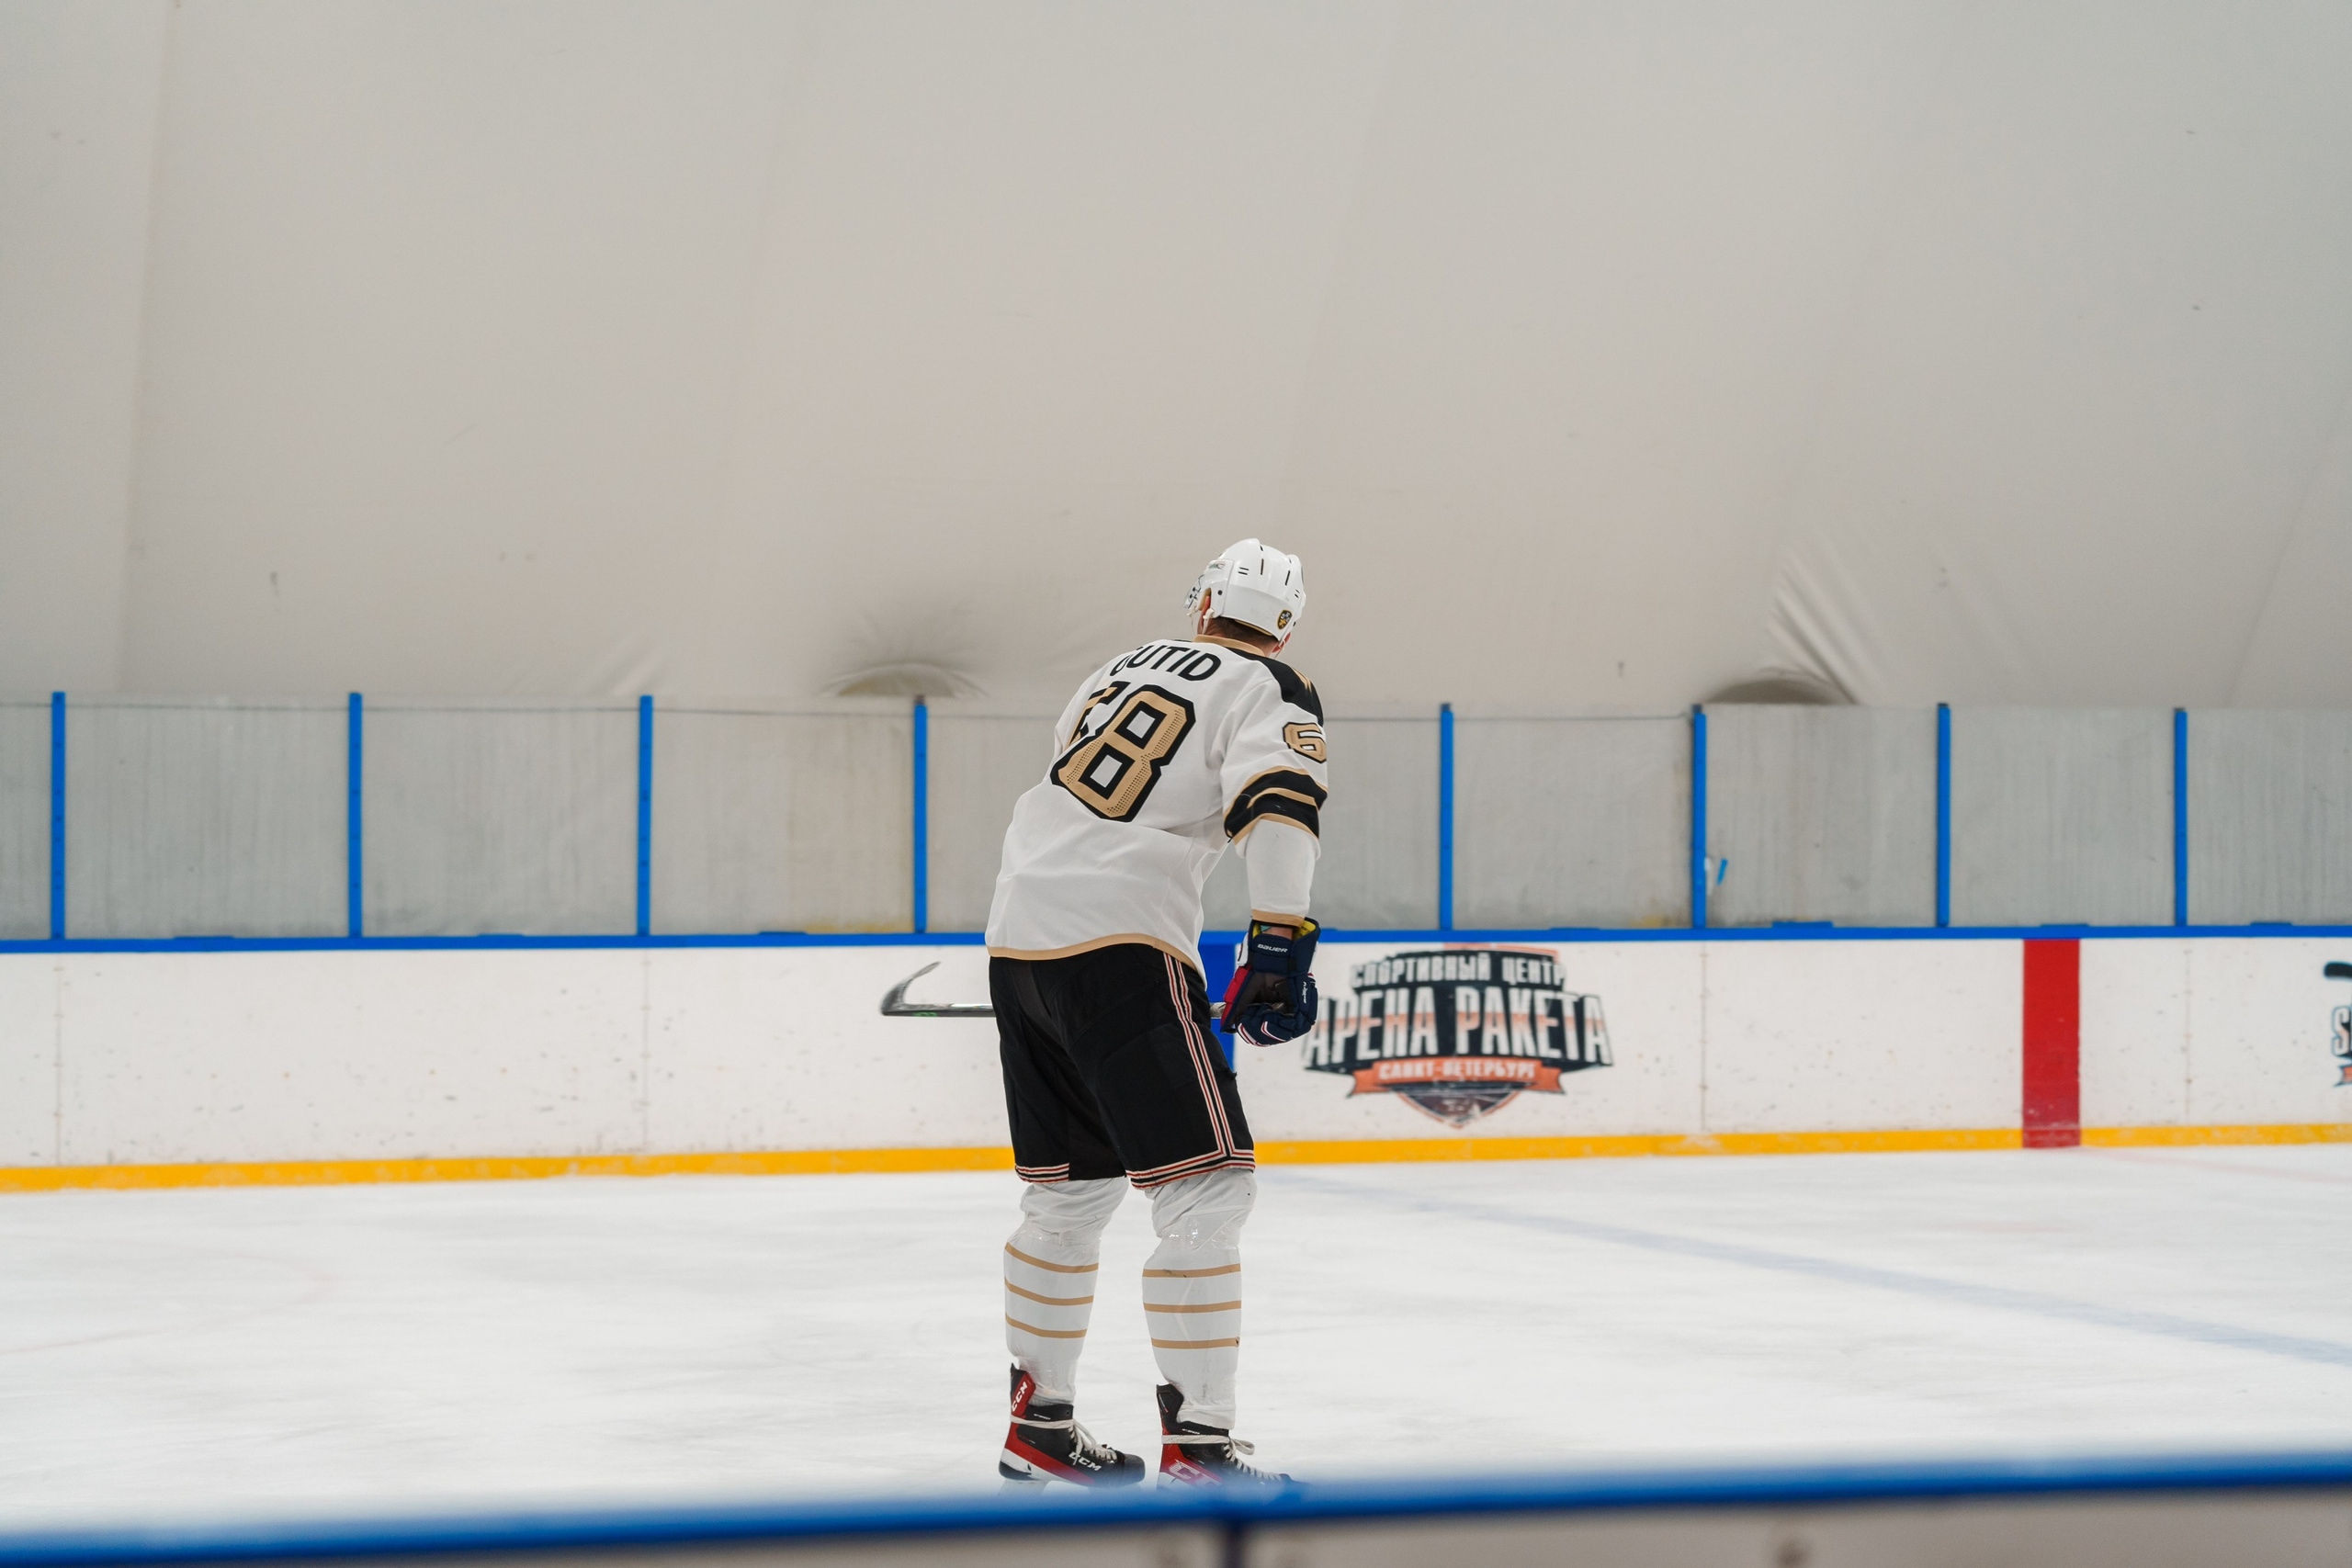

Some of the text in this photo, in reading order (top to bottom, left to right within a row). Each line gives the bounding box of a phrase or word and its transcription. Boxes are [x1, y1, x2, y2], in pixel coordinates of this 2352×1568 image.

[1351, 952, 1566, 988] СПОРТИВНЫЙ ЦЕНТР
[1305, 986, 1613, 1066] АРЕНА РАКЕТА
[1012, 1381, 1028, 1412] CCM
[1069, 1451, 1102, 1471] CCM
